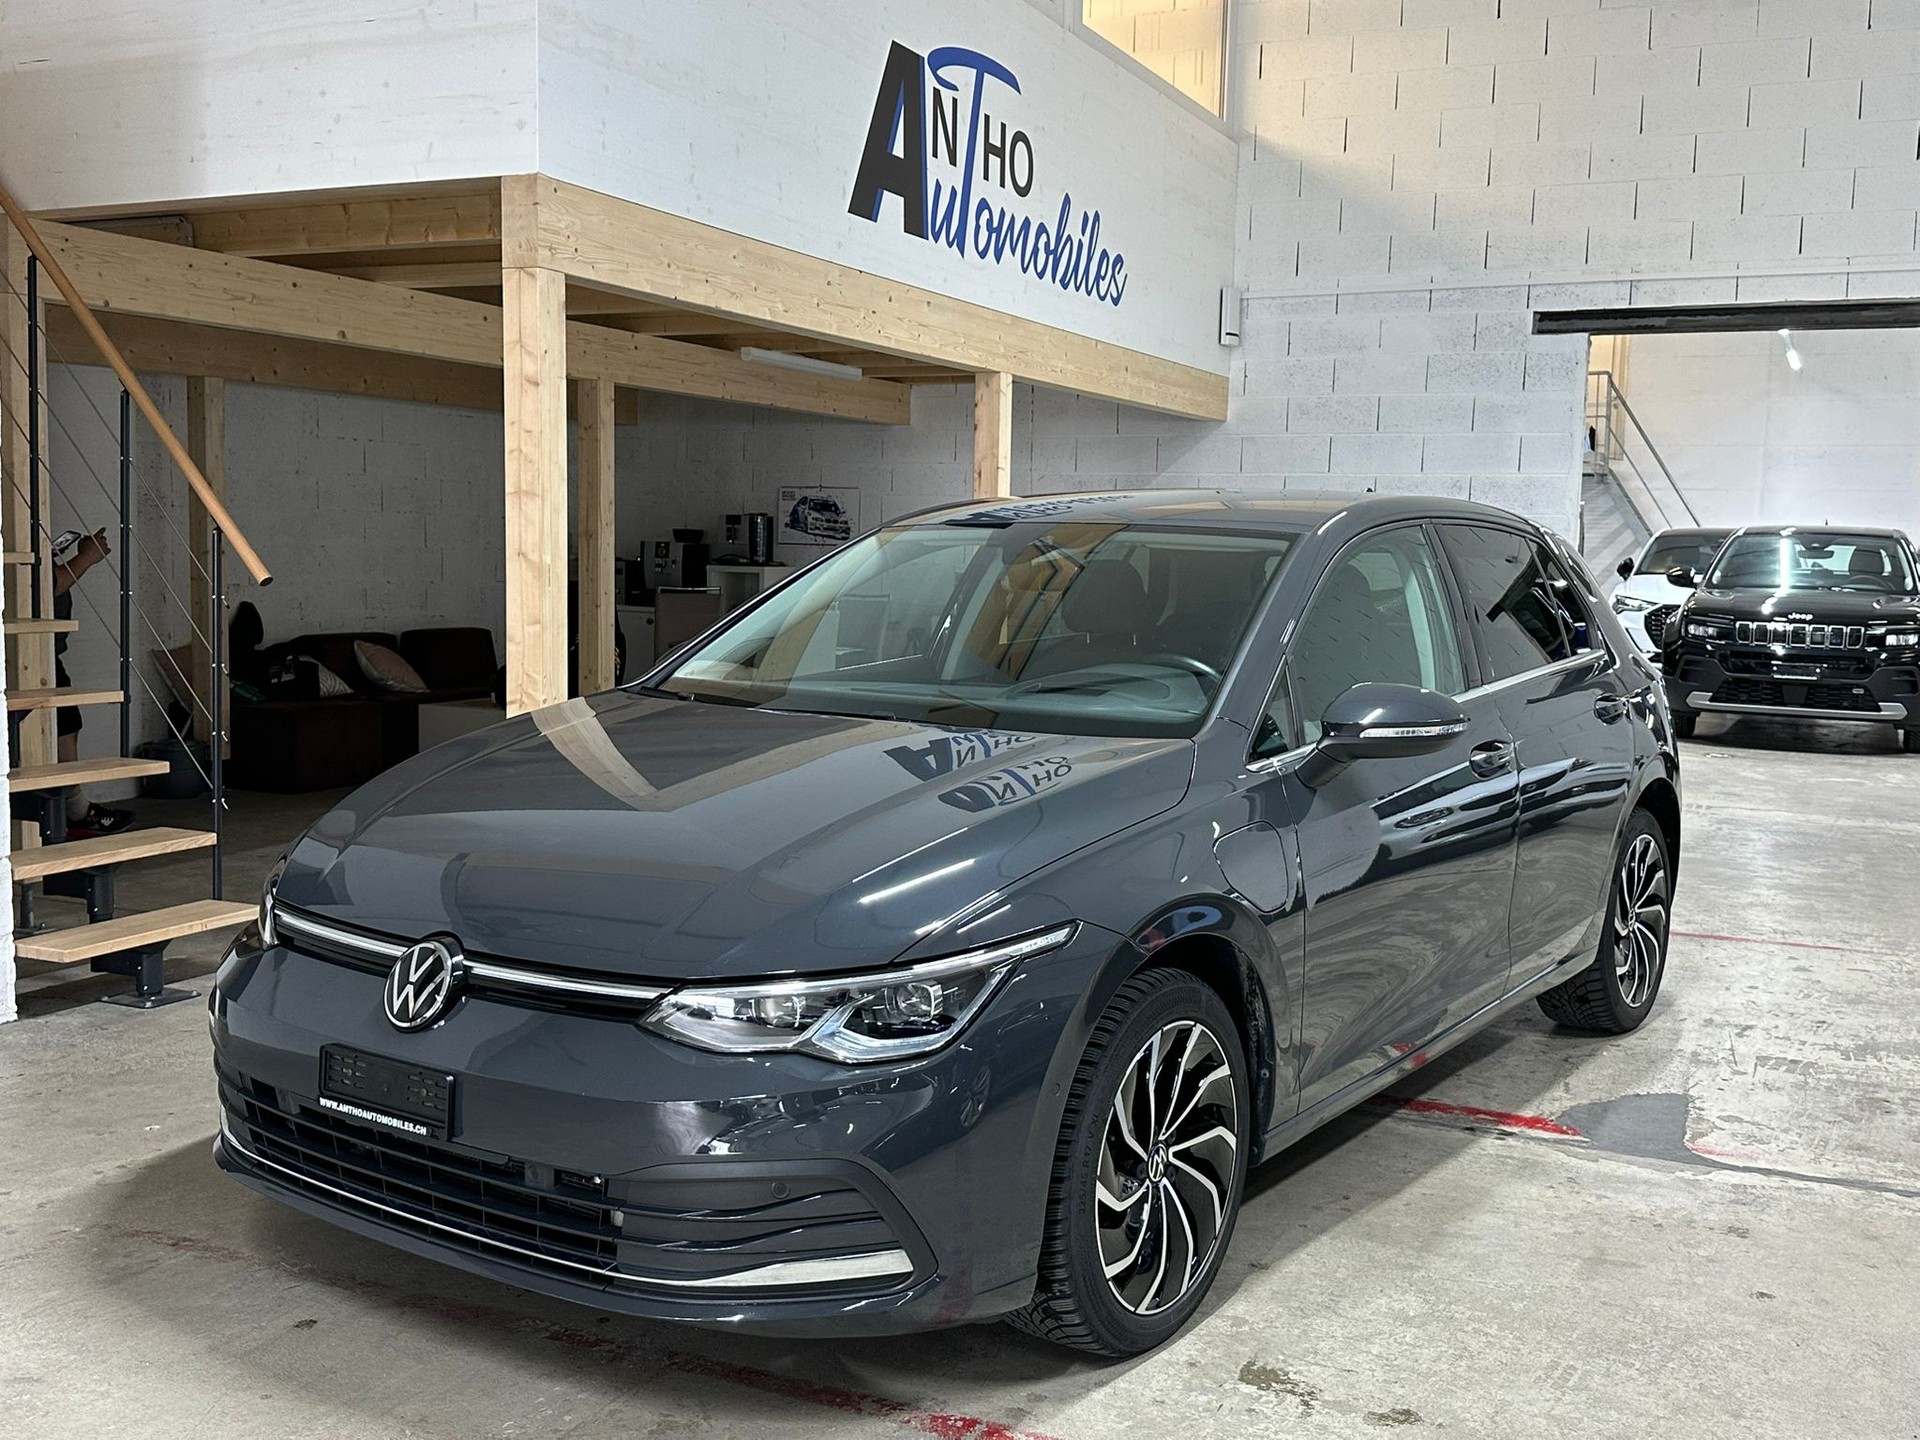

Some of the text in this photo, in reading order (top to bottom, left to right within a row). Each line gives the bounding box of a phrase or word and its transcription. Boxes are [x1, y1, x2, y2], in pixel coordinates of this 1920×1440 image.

[1787, 612, 1813, 621] Jeep
[389, 943, 450, 1022] VW
[319, 1097, 427, 1136] WWW.ANTHOAUTOMOBILES.CH
